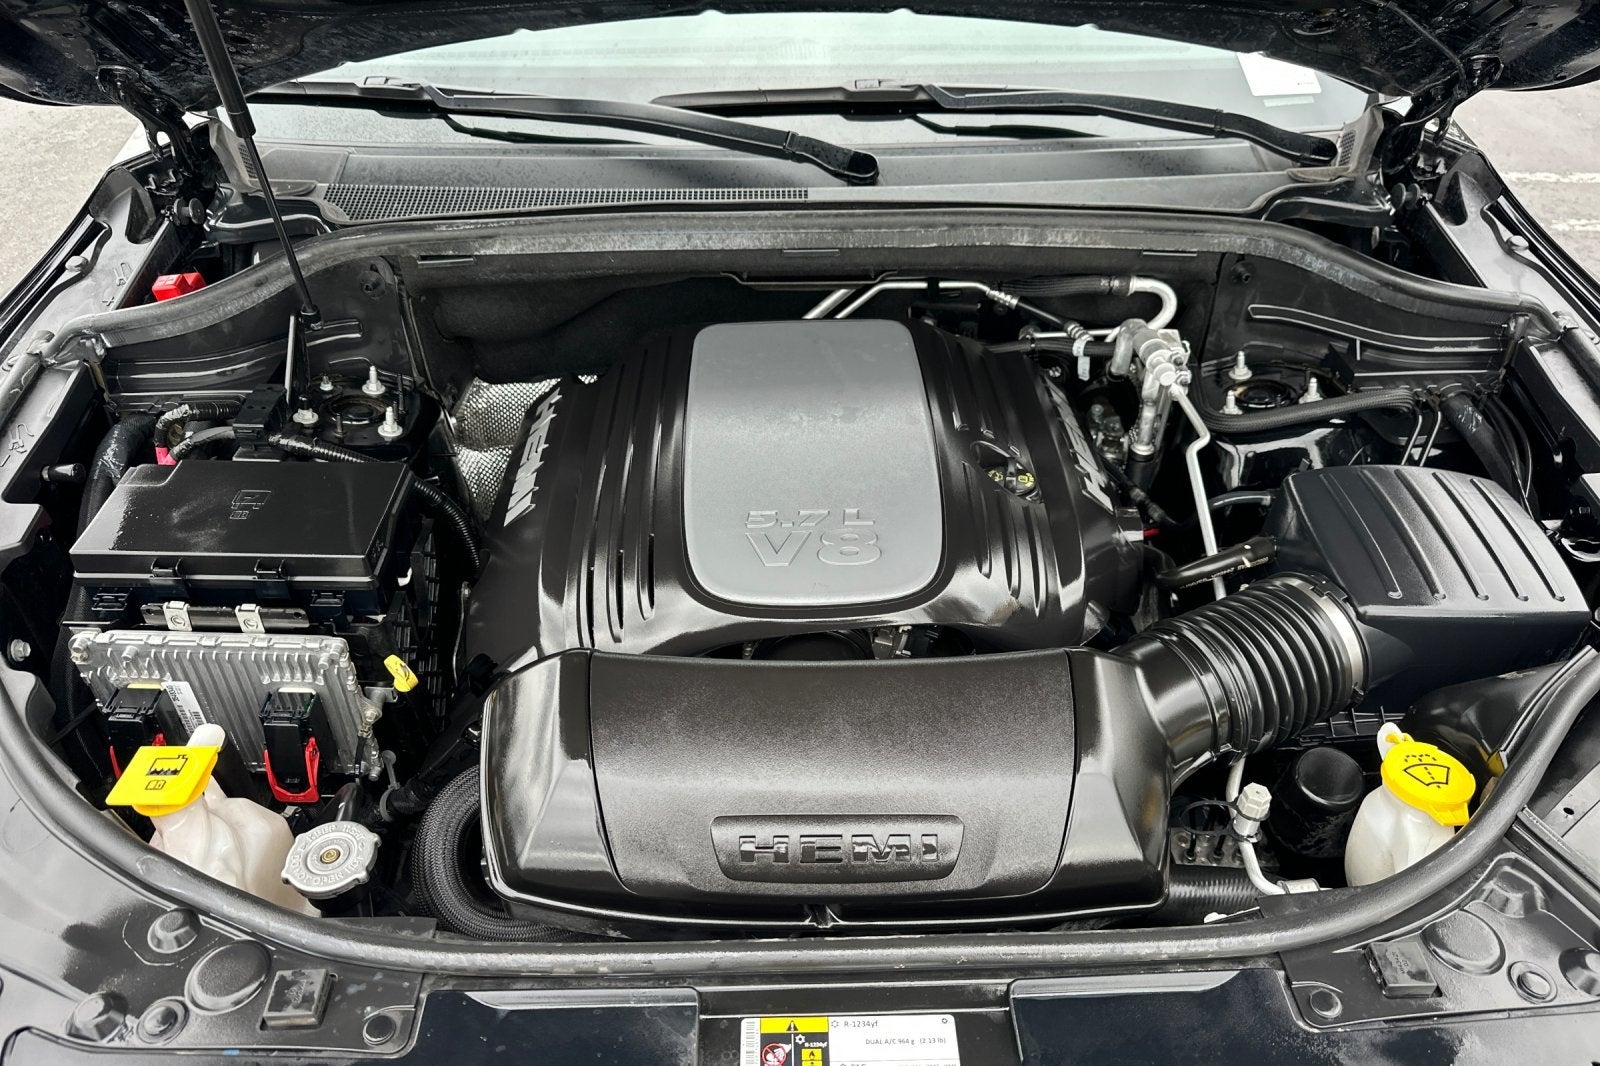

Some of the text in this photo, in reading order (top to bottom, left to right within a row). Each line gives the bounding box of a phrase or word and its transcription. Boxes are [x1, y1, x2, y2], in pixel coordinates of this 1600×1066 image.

[745, 529, 882, 567] V8
[306, 824, 337, 843] KEEP
[739, 833, 939, 864] HEMI
[313, 872, 344, 886] OPEN
[843, 1019, 879, 1029] R-1234yf
[884, 1038, 897, 1046] A/C
[937, 1037, 947, 1045] lb)
